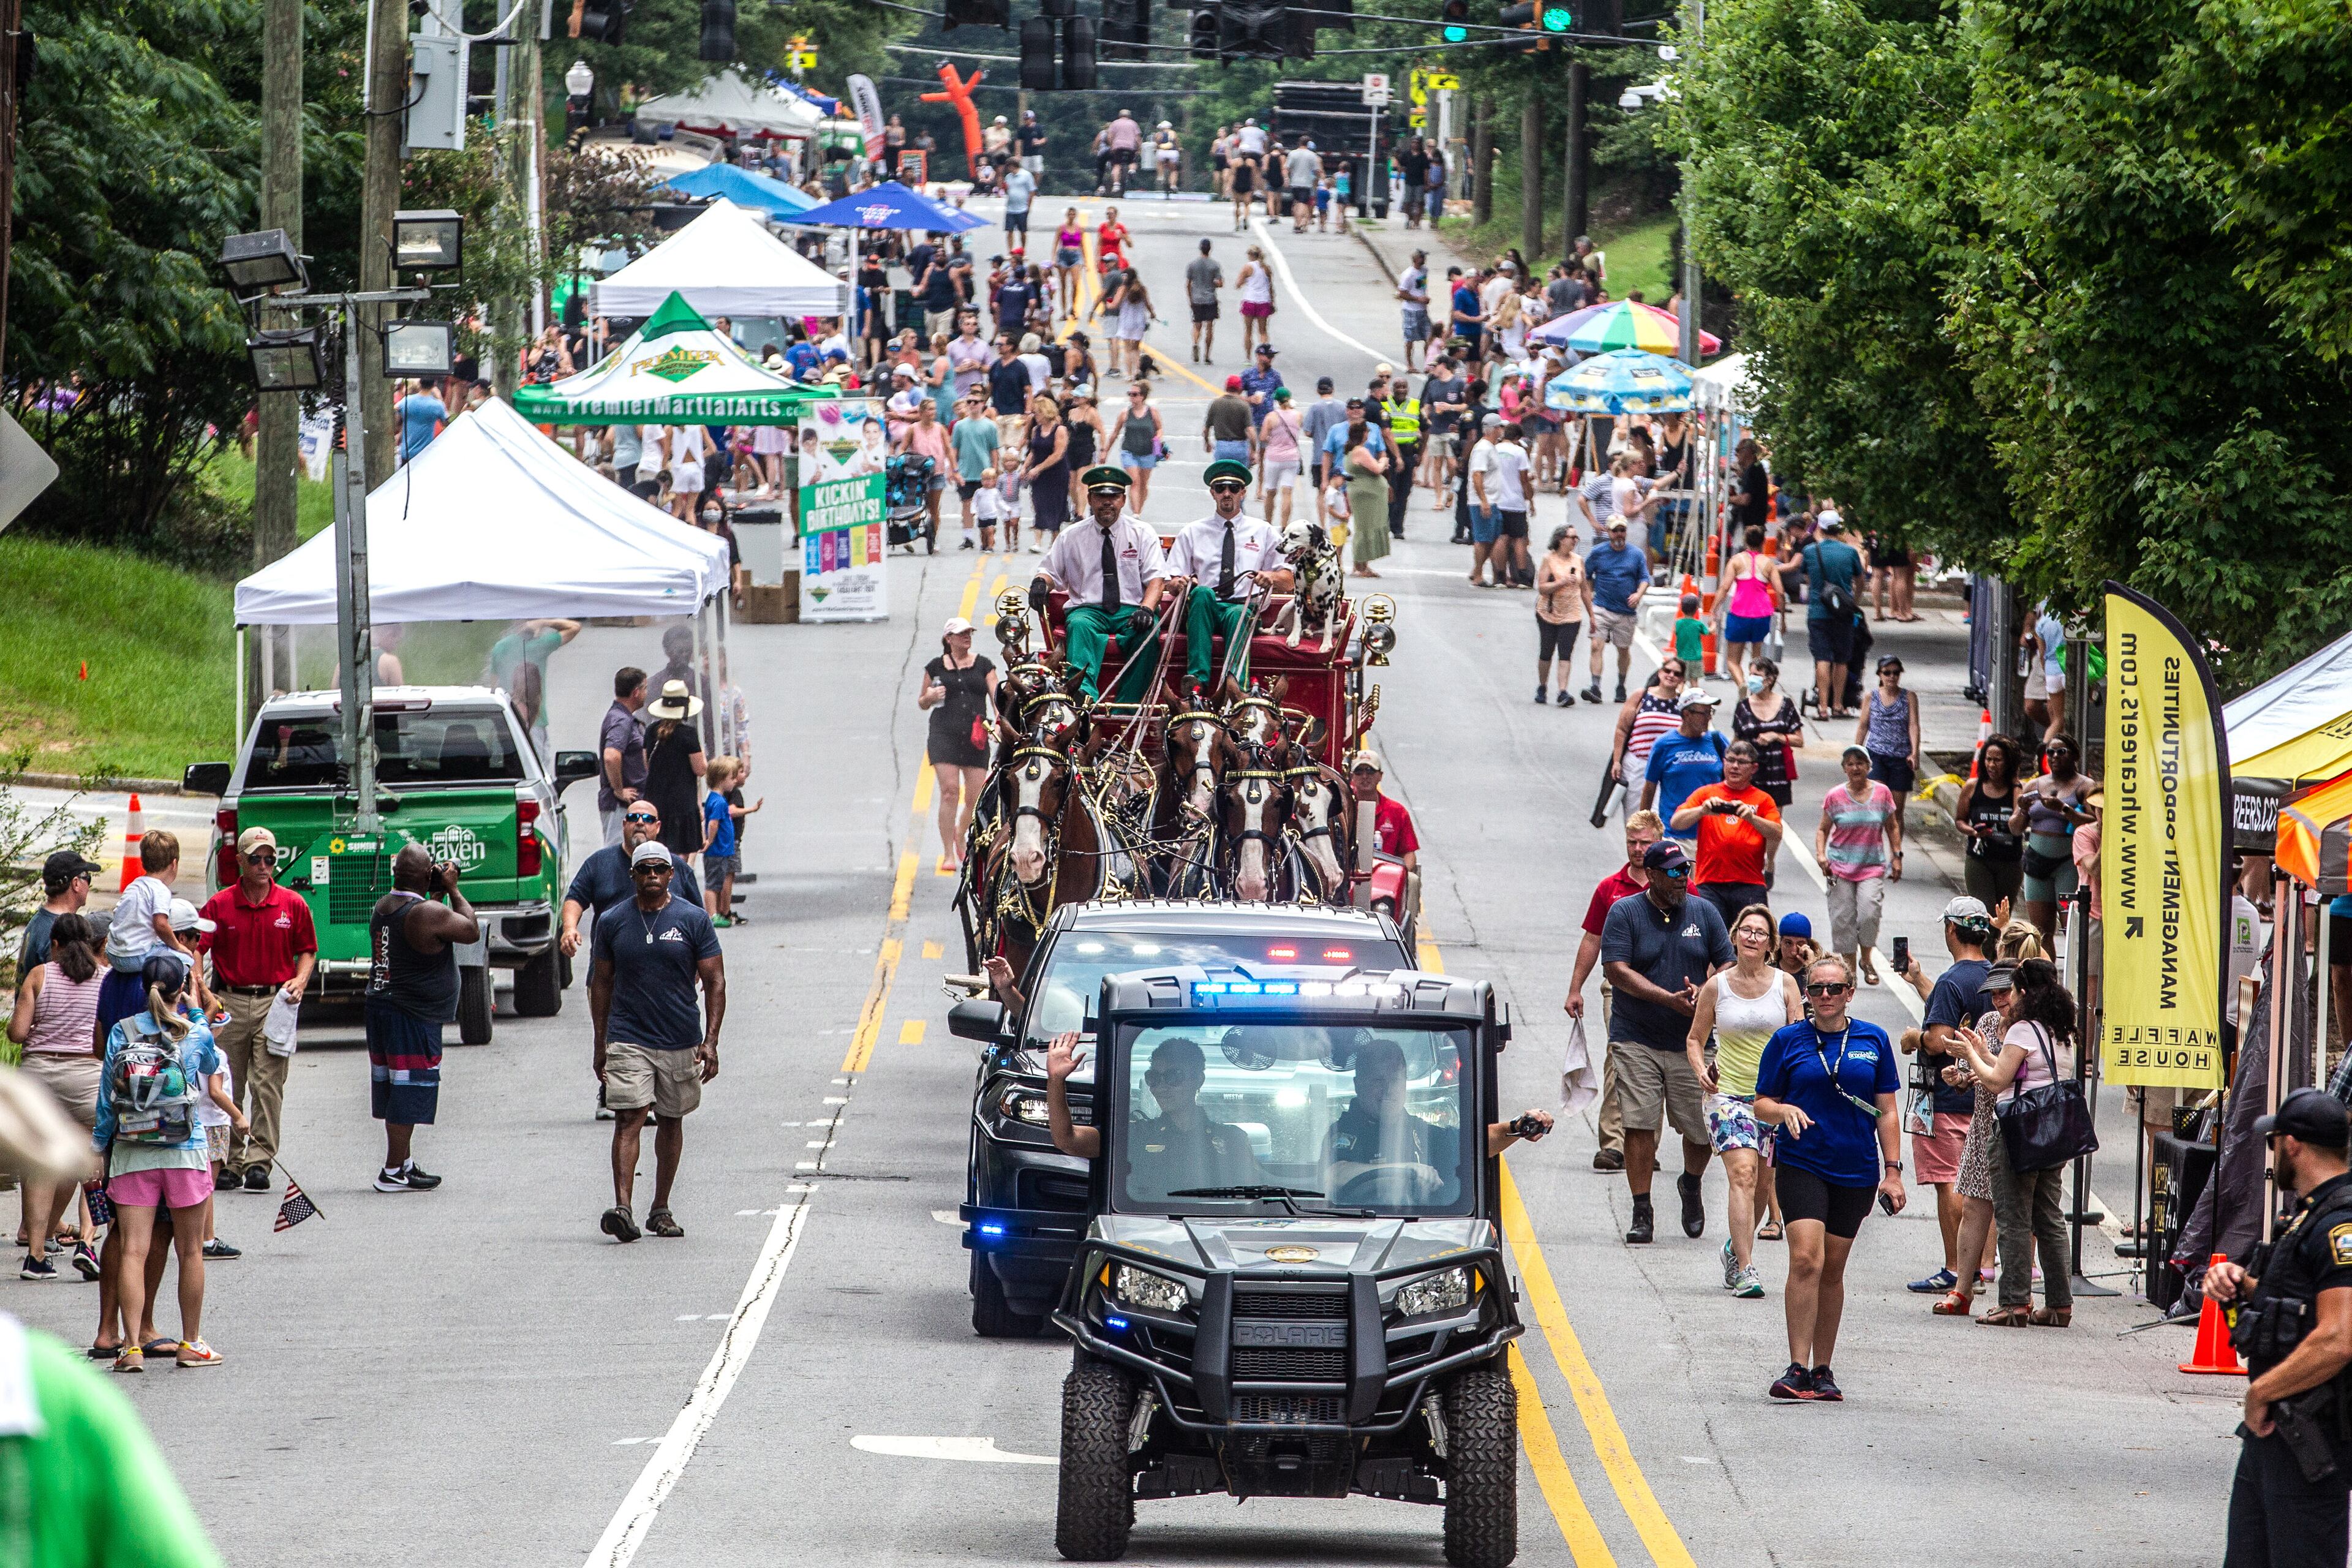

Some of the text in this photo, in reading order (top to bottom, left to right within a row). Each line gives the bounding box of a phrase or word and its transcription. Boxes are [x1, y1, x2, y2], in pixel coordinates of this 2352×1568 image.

[630, 350, 725, 377] PREMIER
[815, 478, 870, 509] KICKIN'
[805, 498, 881, 533] BIRTHDAYS!
[1848, 1052, 1879, 1061] Brookhaven
[1235, 1325, 1348, 1344] POLARIS
